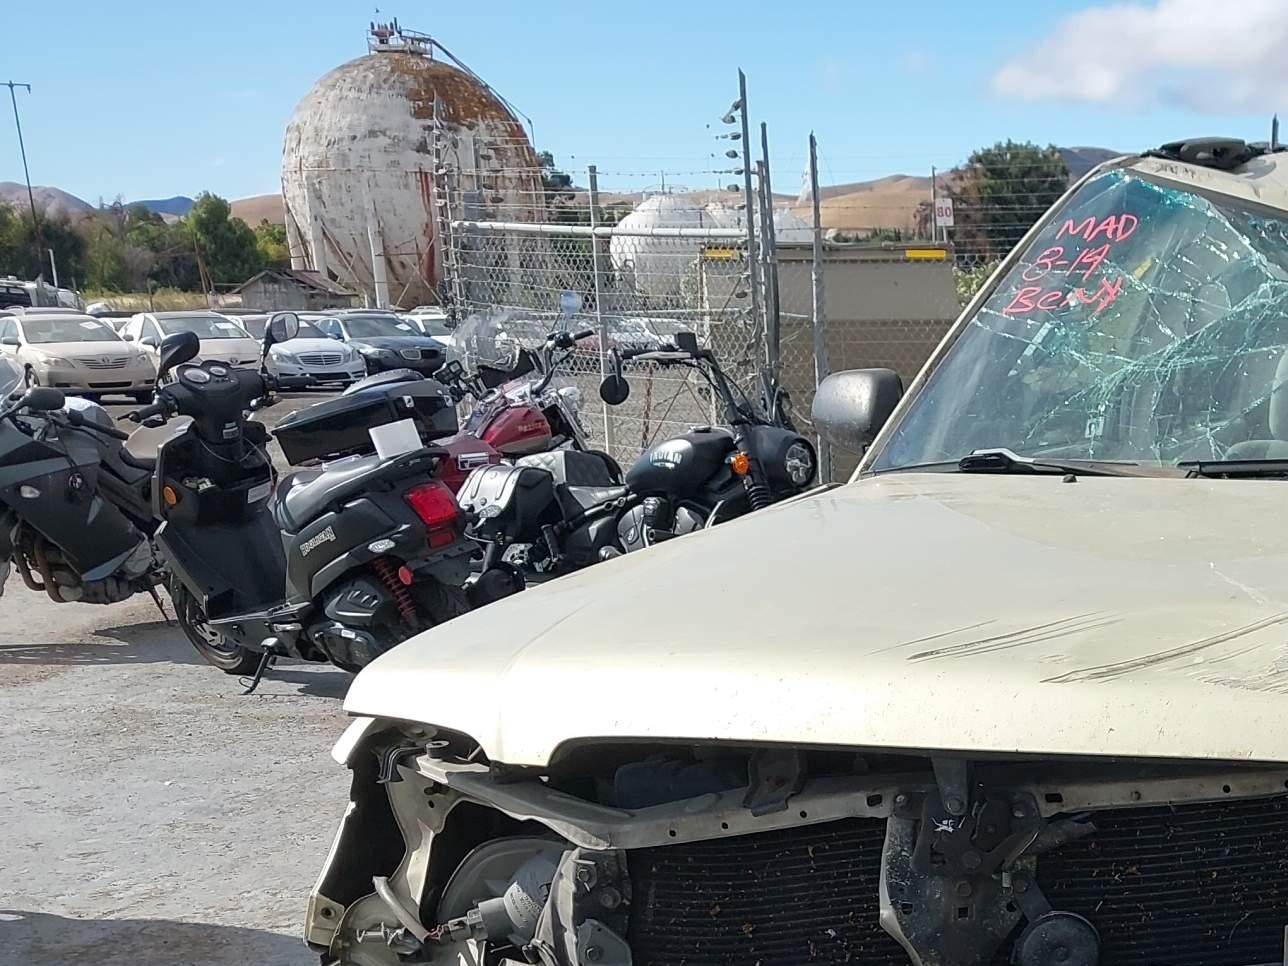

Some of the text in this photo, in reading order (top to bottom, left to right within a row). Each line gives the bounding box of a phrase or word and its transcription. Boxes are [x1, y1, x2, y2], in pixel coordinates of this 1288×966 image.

[937, 206, 952, 218] 80
[1055, 214, 1138, 242] MAD
[650, 450, 682, 464] INDIAN
